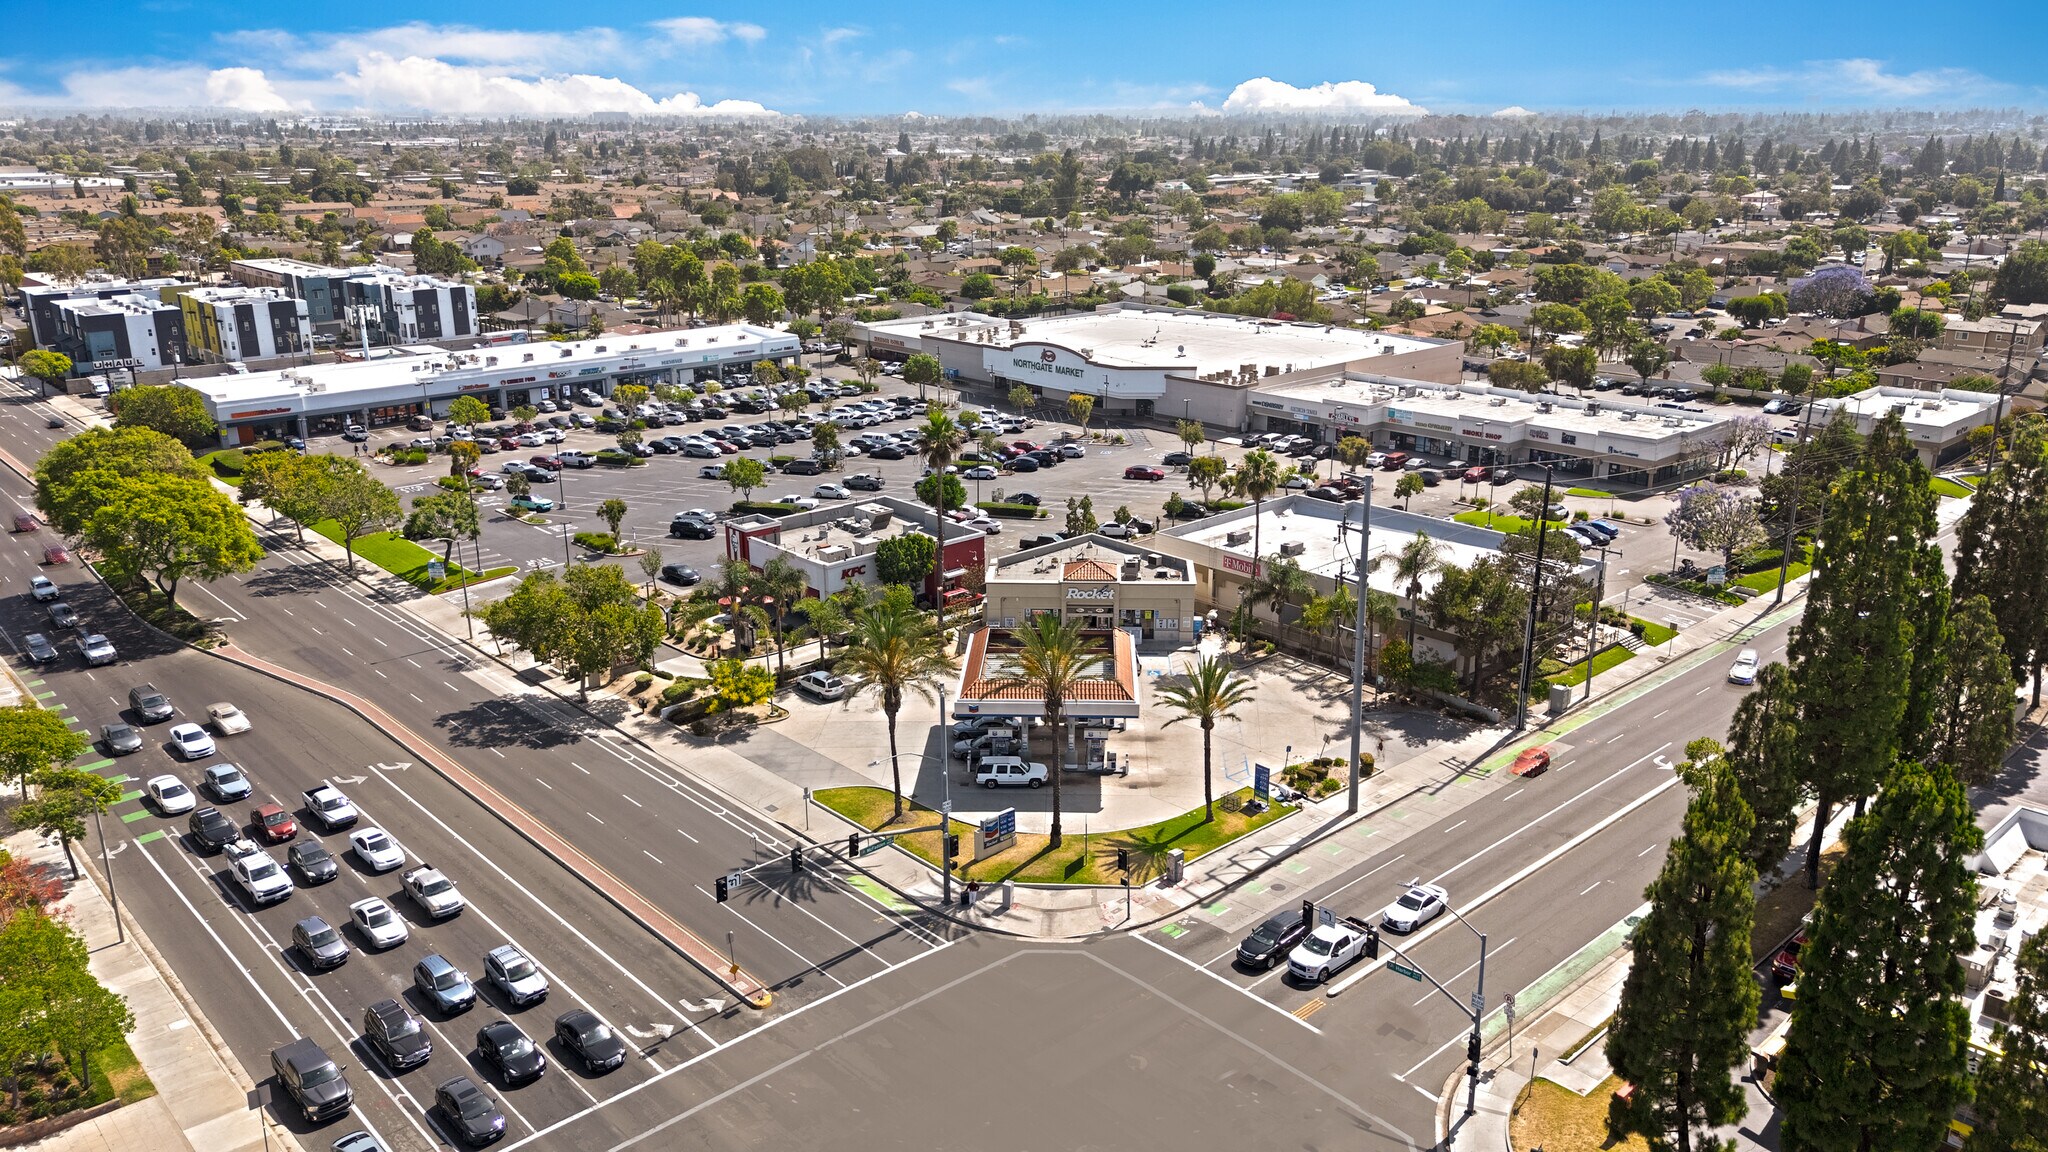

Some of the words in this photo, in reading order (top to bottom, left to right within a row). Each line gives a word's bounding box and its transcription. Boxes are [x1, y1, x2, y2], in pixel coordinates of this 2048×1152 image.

[1012, 358, 1053, 373] NORTHGATE
[1055, 365, 1084, 378] MARKET
[1462, 429, 1483, 438] SMOKE
[1485, 432, 1502, 440] SHOP
[841, 564, 866, 579] KFC
[1066, 587, 1115, 599] Rocket
